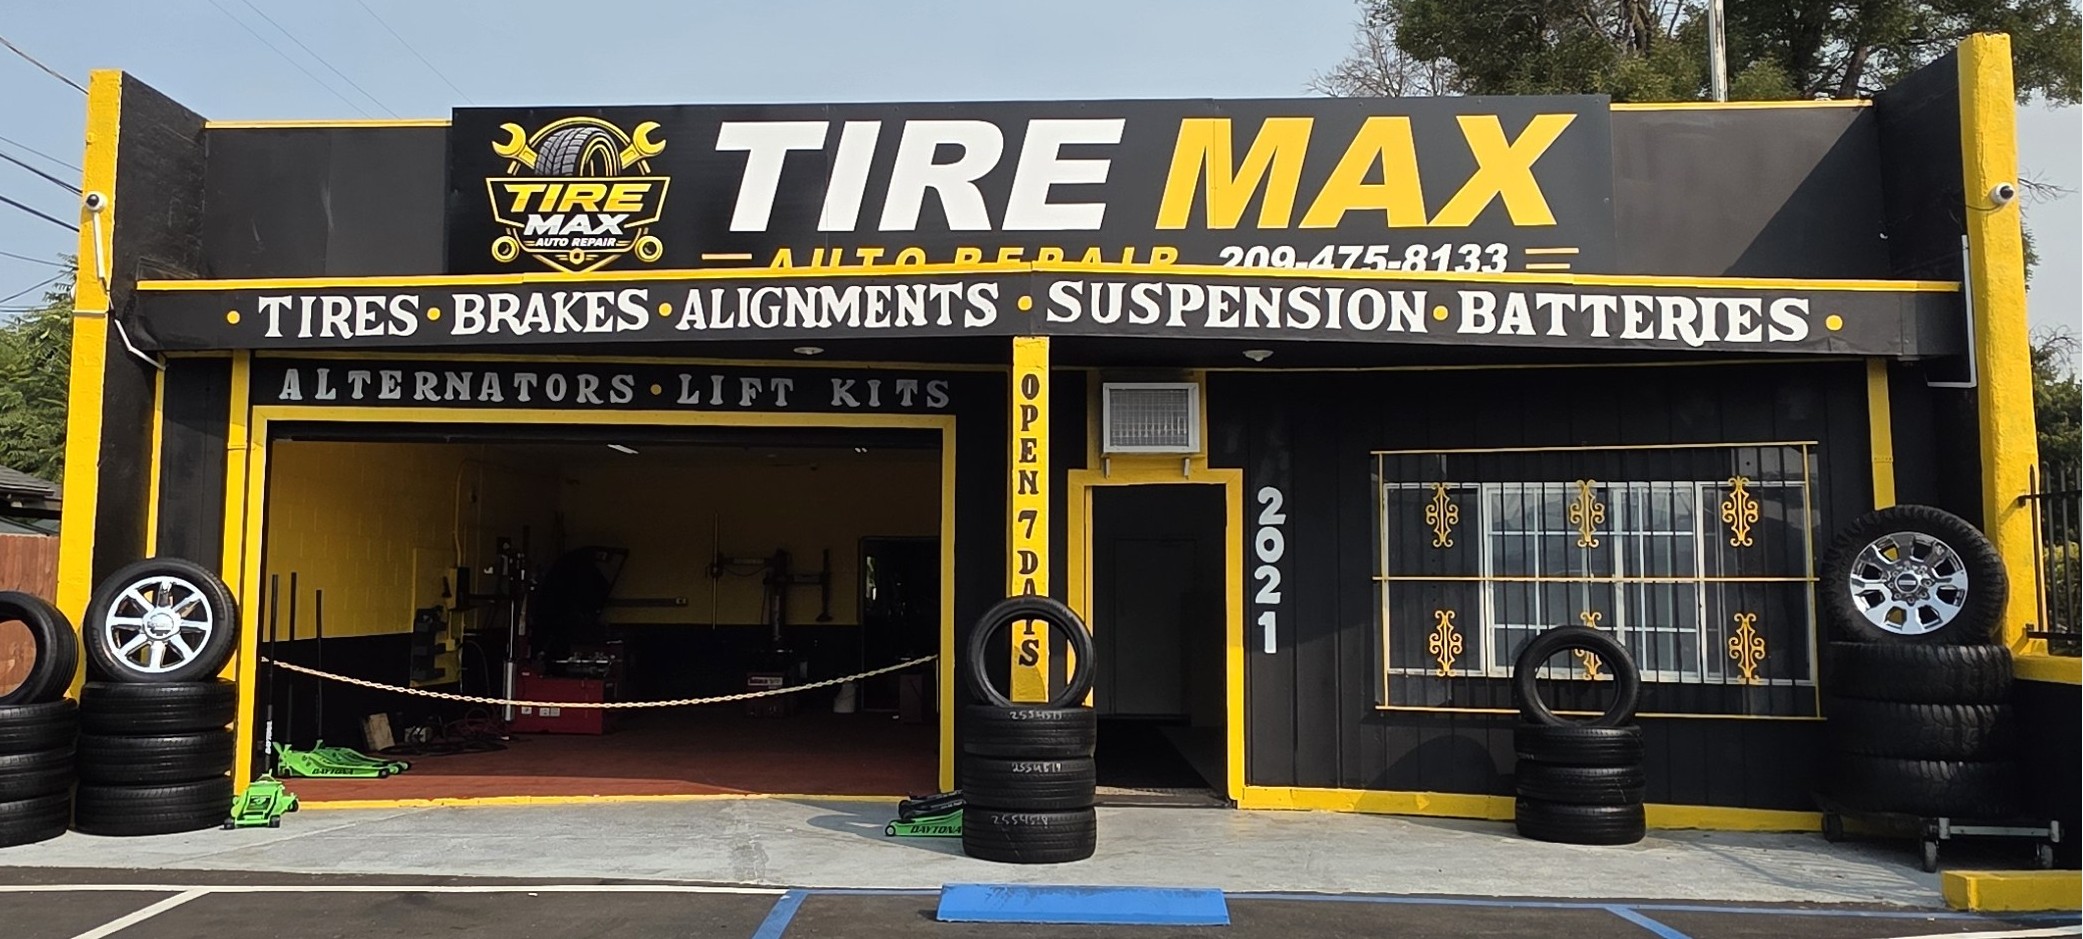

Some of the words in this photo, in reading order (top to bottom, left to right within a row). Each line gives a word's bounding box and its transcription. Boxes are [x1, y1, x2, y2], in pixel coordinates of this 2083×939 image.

[715, 118, 1126, 231] TIRE
[1155, 114, 1577, 230] MAX
[504, 183, 652, 213] TIRE
[523, 213, 630, 236] MAX
[535, 237, 567, 247] AUTO
[571, 237, 617, 247] REPAIR
[1219, 243, 1509, 272] 209-475-8133
[258, 294, 420, 339] TIRES
[450, 288, 649, 335] BRAKES
[675, 282, 999, 331] ALIGNMENTS
[1046, 280, 1428, 333] SUSPENSION
[1457, 290, 1810, 347] BATTERIES
[279, 368, 635, 404] ALTERNATORS
[677, 373, 793, 407] LIFT
[830, 377, 950, 408] KITS
[1018, 373, 1040, 495] OPEN
[1018, 510, 1038, 539] 7
[1254, 486, 1287, 654] 2021
[910, 825, 962, 834] DAYTONA
